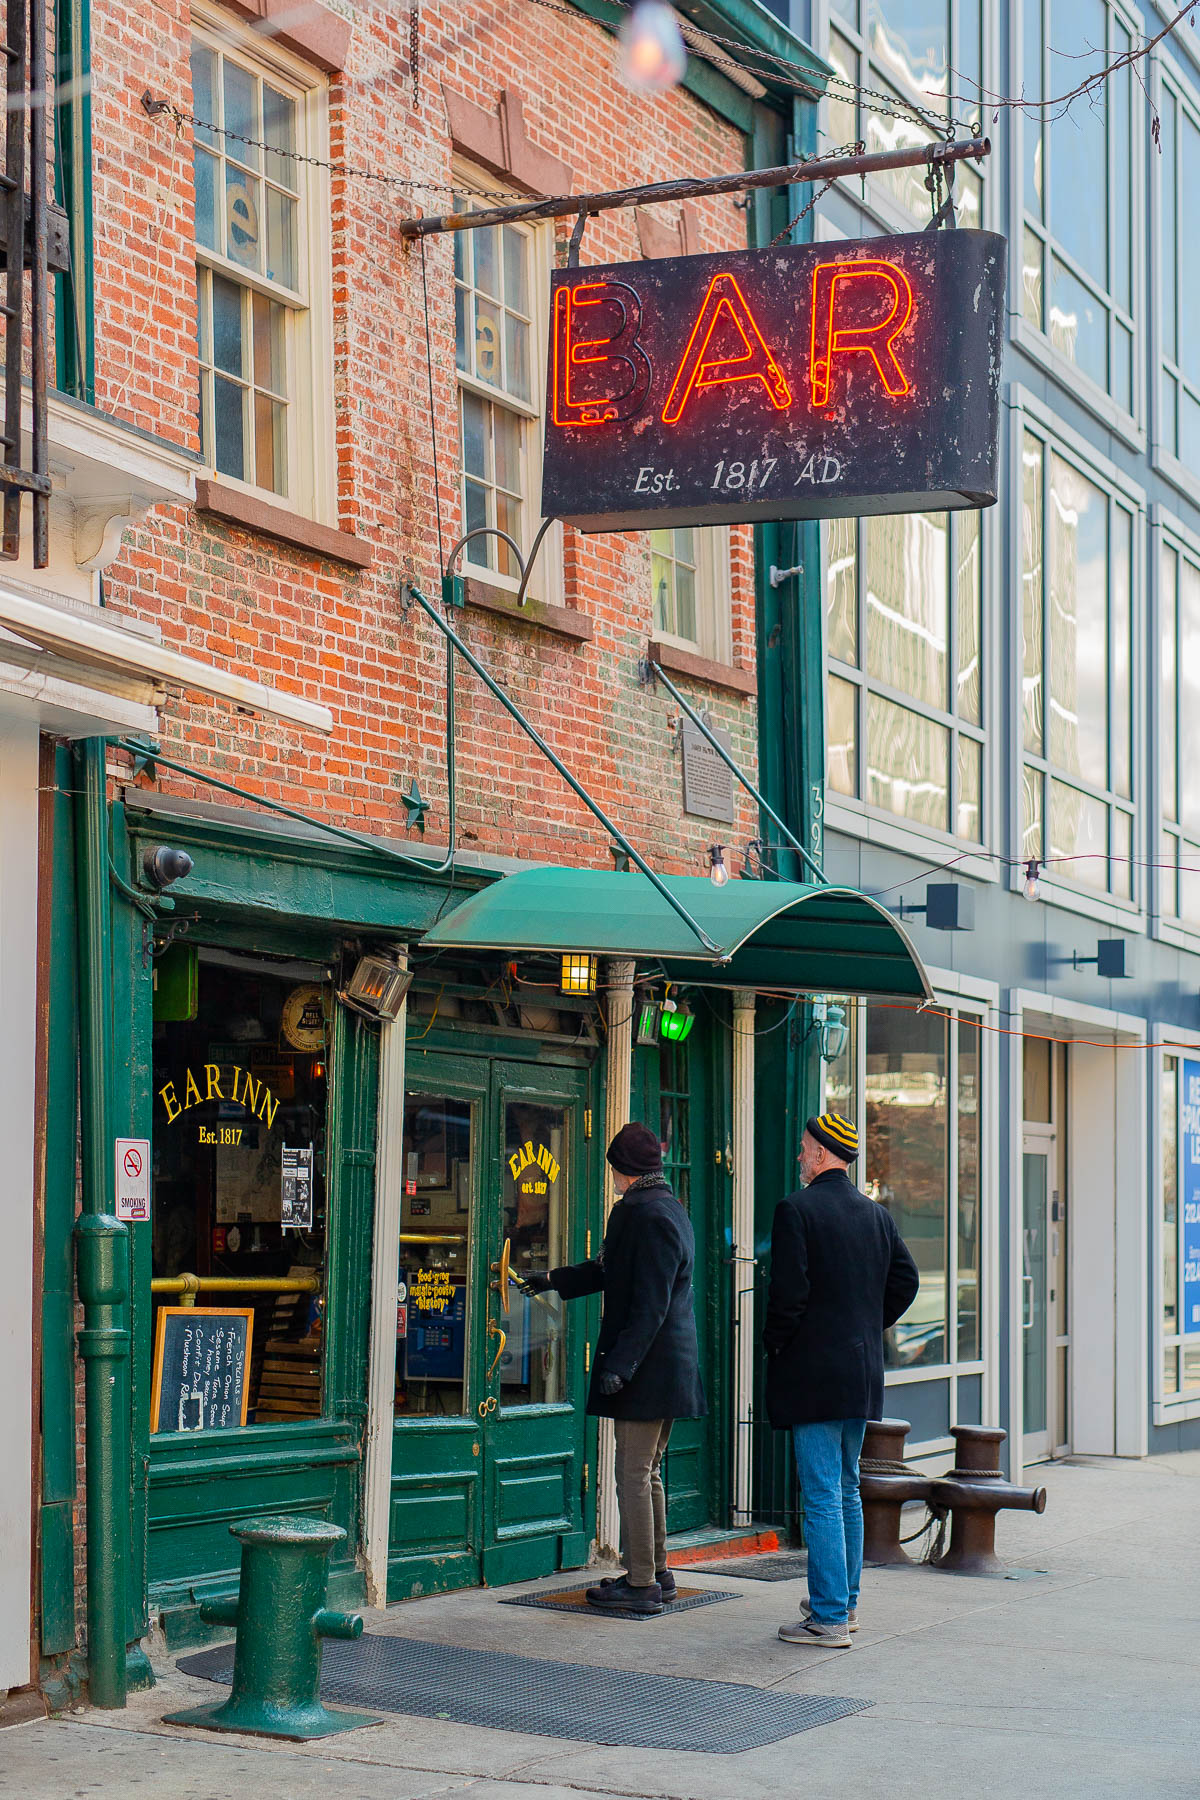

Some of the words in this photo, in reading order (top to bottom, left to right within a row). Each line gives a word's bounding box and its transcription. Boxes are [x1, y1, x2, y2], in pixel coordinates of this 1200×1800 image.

[553, 259, 913, 427] BAR
[634, 467, 681, 493] Est.
[710, 457, 777, 489] 1817
[794, 453, 844, 486] A.D.
[159, 1064, 225, 1125] EAR
[231, 1065, 280, 1130] INN
[198, 1126, 218, 1145] Est.
[219, 1128, 243, 1146] 1817
[509, 1140, 536, 1181] EAR
[537, 1143, 560, 1184] INN
[121, 1197, 146, 1209] SMOKING
[182, 1329, 192, 1377] Mushroom
[194, 1328, 204, 1367] Confit
[202, 1348, 214, 1376] honey
[214, 1329, 225, 1371] Sesame
[226, 1331, 236, 1367] French
[192, 1371, 202, 1393] Duc
[212, 1377, 221, 1400] Tuna
[223, 1374, 233, 1400] Onion
[219, 1404, 231, 1427] Soup
